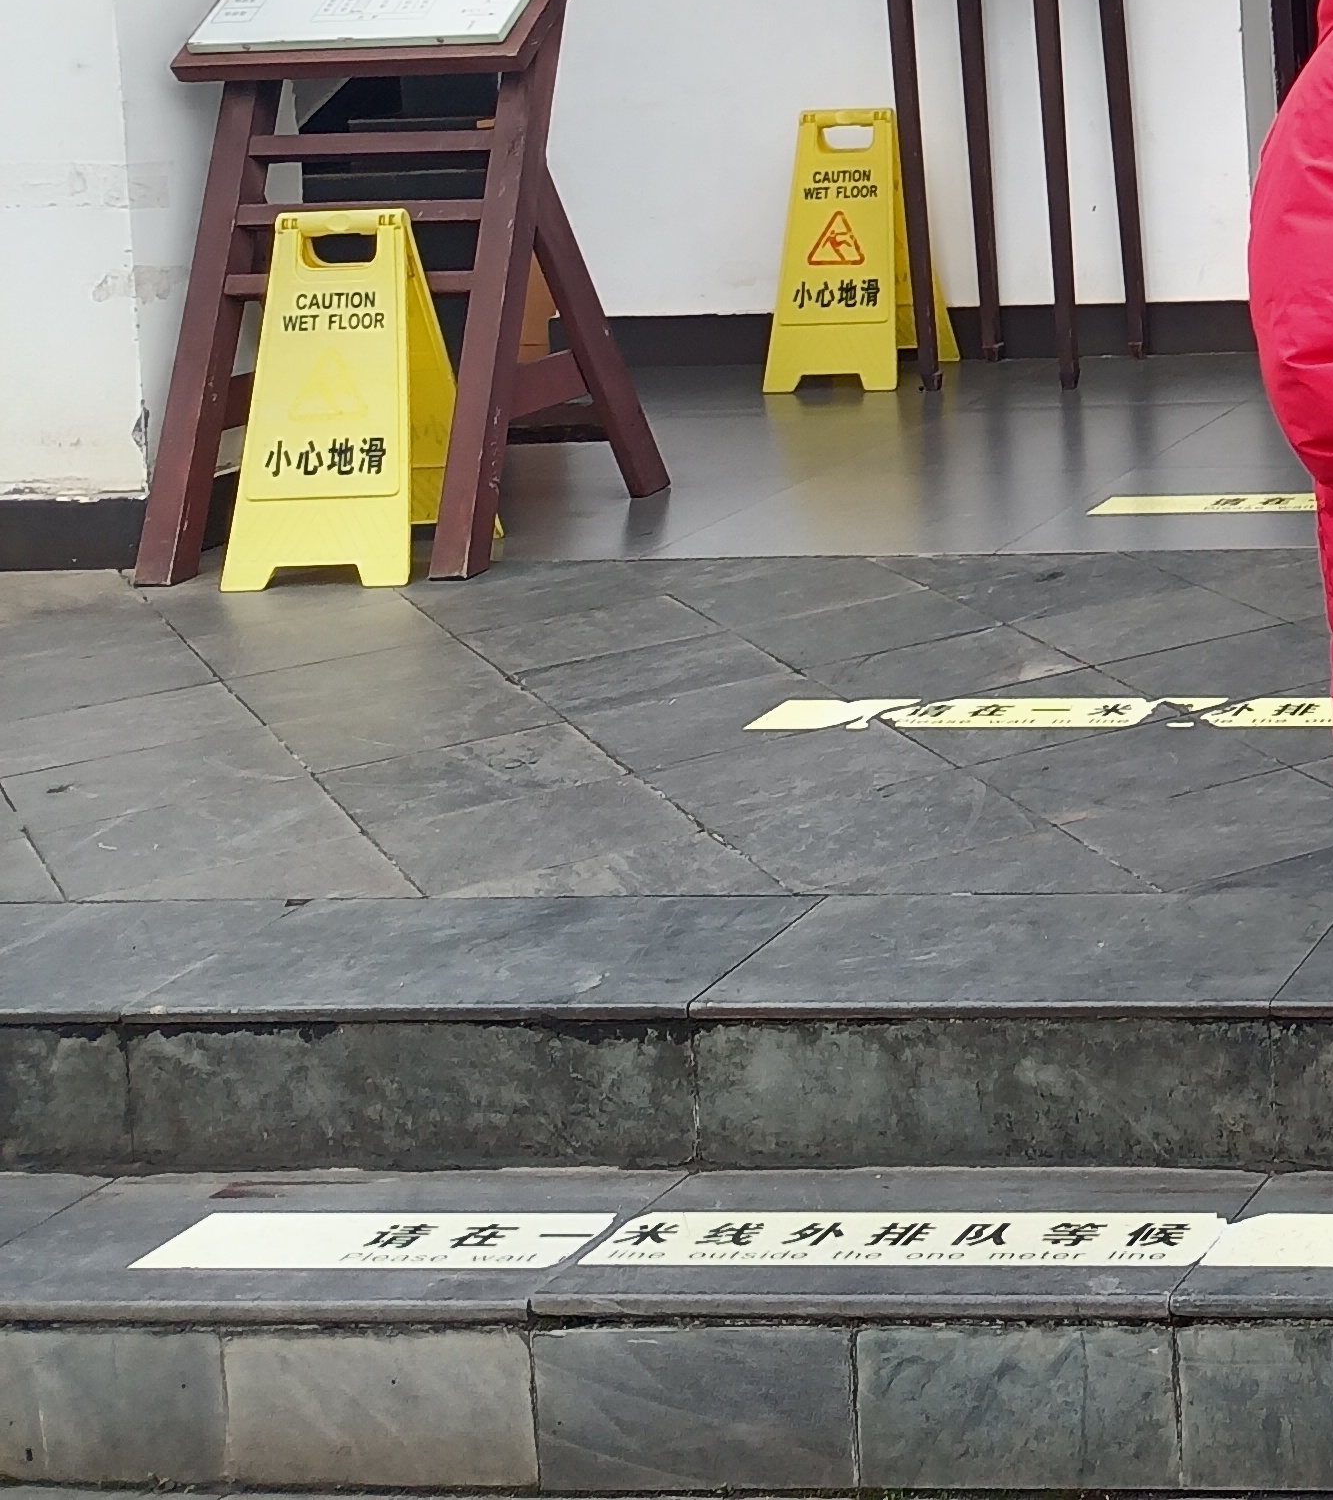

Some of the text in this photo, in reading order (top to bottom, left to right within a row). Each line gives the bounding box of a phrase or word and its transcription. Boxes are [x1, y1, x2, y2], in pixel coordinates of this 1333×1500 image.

[812, 169, 872, 184] CAUTION
[803, 184, 878, 200] WET FLOOR
[295, 291, 377, 310] CAUTION
[793, 278, 880, 309] 小心地滑
[283, 313, 385, 332] WET FLOOR
[265, 436, 386, 478] 小心地滑
[363, 1222, 1191, 1250] 请在一米线外排队等候
[339, 1251, 448, 1263] Please
[472, 1252, 538, 1263] wait
[606, 1250, 666, 1260] line
[688, 1250, 809, 1260] outside
[831, 1250, 882, 1260] the
[904, 1251, 966, 1260] one
[988, 1251, 1087, 1260] meter
[1107, 1250, 1168, 1260] line
